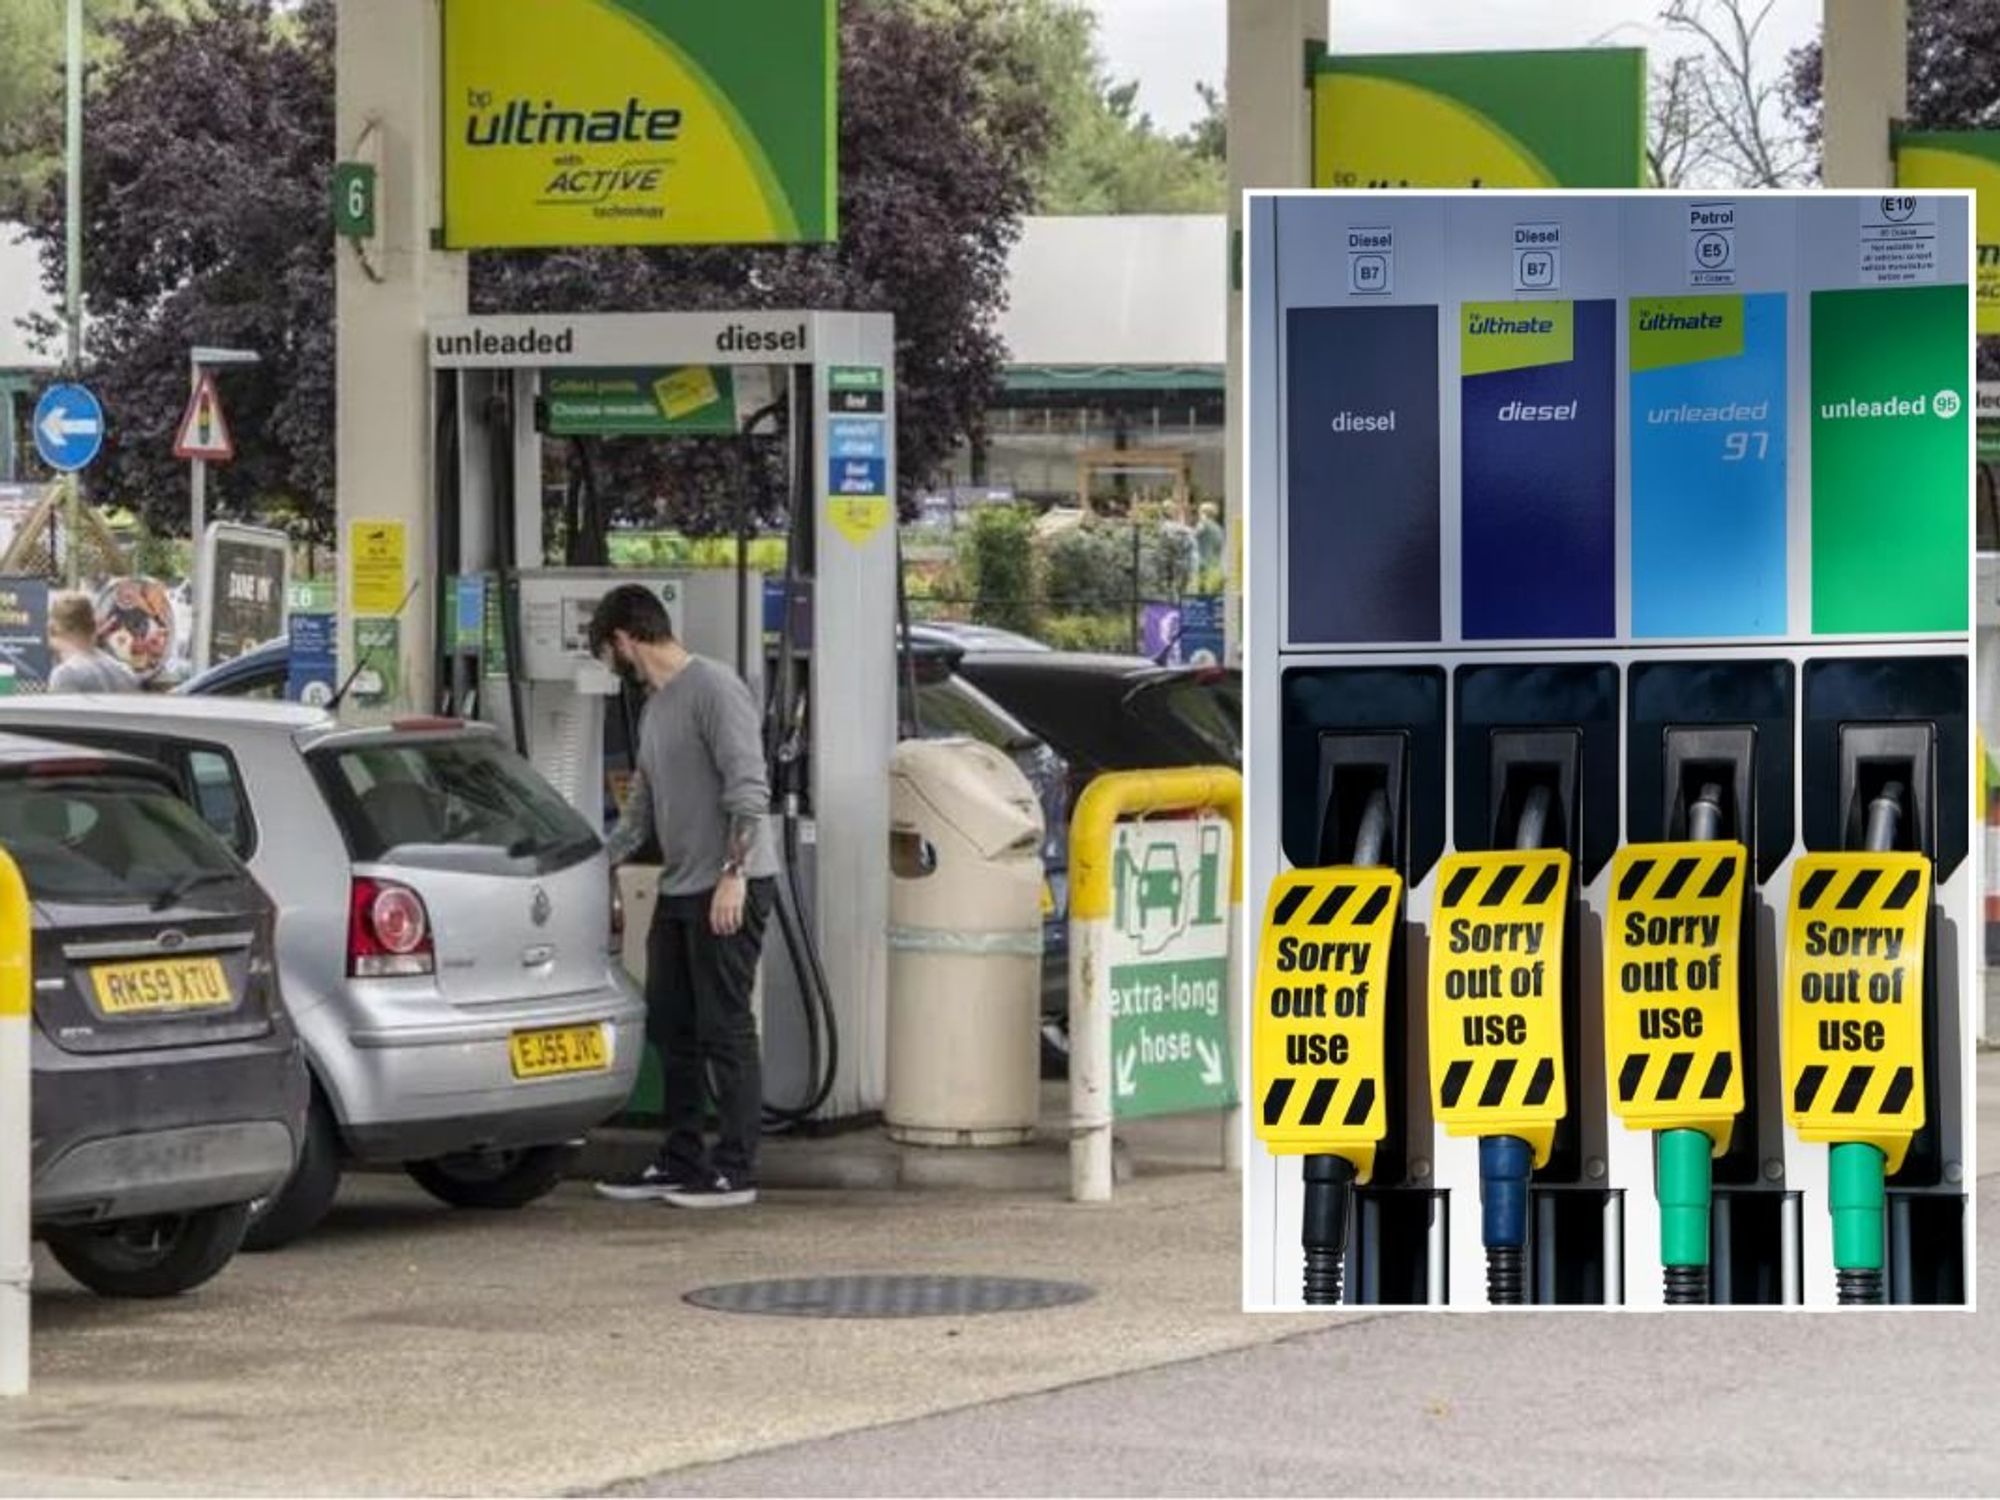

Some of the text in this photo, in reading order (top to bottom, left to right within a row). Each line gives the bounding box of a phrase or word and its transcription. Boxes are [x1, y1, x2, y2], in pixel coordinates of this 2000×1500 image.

[466, 97, 682, 145] ultimate
[544, 167, 664, 194] ACTIVE
[348, 178, 364, 218] 6
[1885, 197, 1913, 212] E10
[1690, 210, 1734, 225] Petrol
[1348, 232, 1393, 248] Diesel
[1514, 228, 1560, 244] Diesel
[1702, 243, 1722, 258] E5
[1360, 266, 1380, 281] B7
[1526, 261, 1547, 277] B7
[1468, 315, 1554, 335] ultimate
[1639, 312, 1723, 331] ultimate
[436, 328, 573, 356] unleaded
[716, 325, 807, 353] diesel
[1331, 410, 1396, 432] diesel
[1497, 400, 1578, 421] diesel
[1647, 400, 1769, 424] unleaded
[1820, 395, 1926, 419] unleaded
[1936, 396, 1957, 412] 95
[1721, 432, 1770, 460] 97
[1449, 919, 1544, 955] Sorry
[1624, 911, 1720, 947] Sorry
[1805, 920, 1904, 960] Sorry
[1276, 937, 1371, 975] Sorry
[1445, 961, 1545, 1000] out of
[1621, 954, 1721, 993] out of
[1801, 967, 1905, 1005] out of
[1110, 974, 1219, 1017] extra-long
[1271, 981, 1369, 1018] out of
[1463, 1014, 1527, 1046] use
[1639, 1006, 1704, 1040] use
[1818, 1019, 1885, 1051] use
[1141, 1028, 1192, 1066] hose
[1286, 1033, 1349, 1065] use
